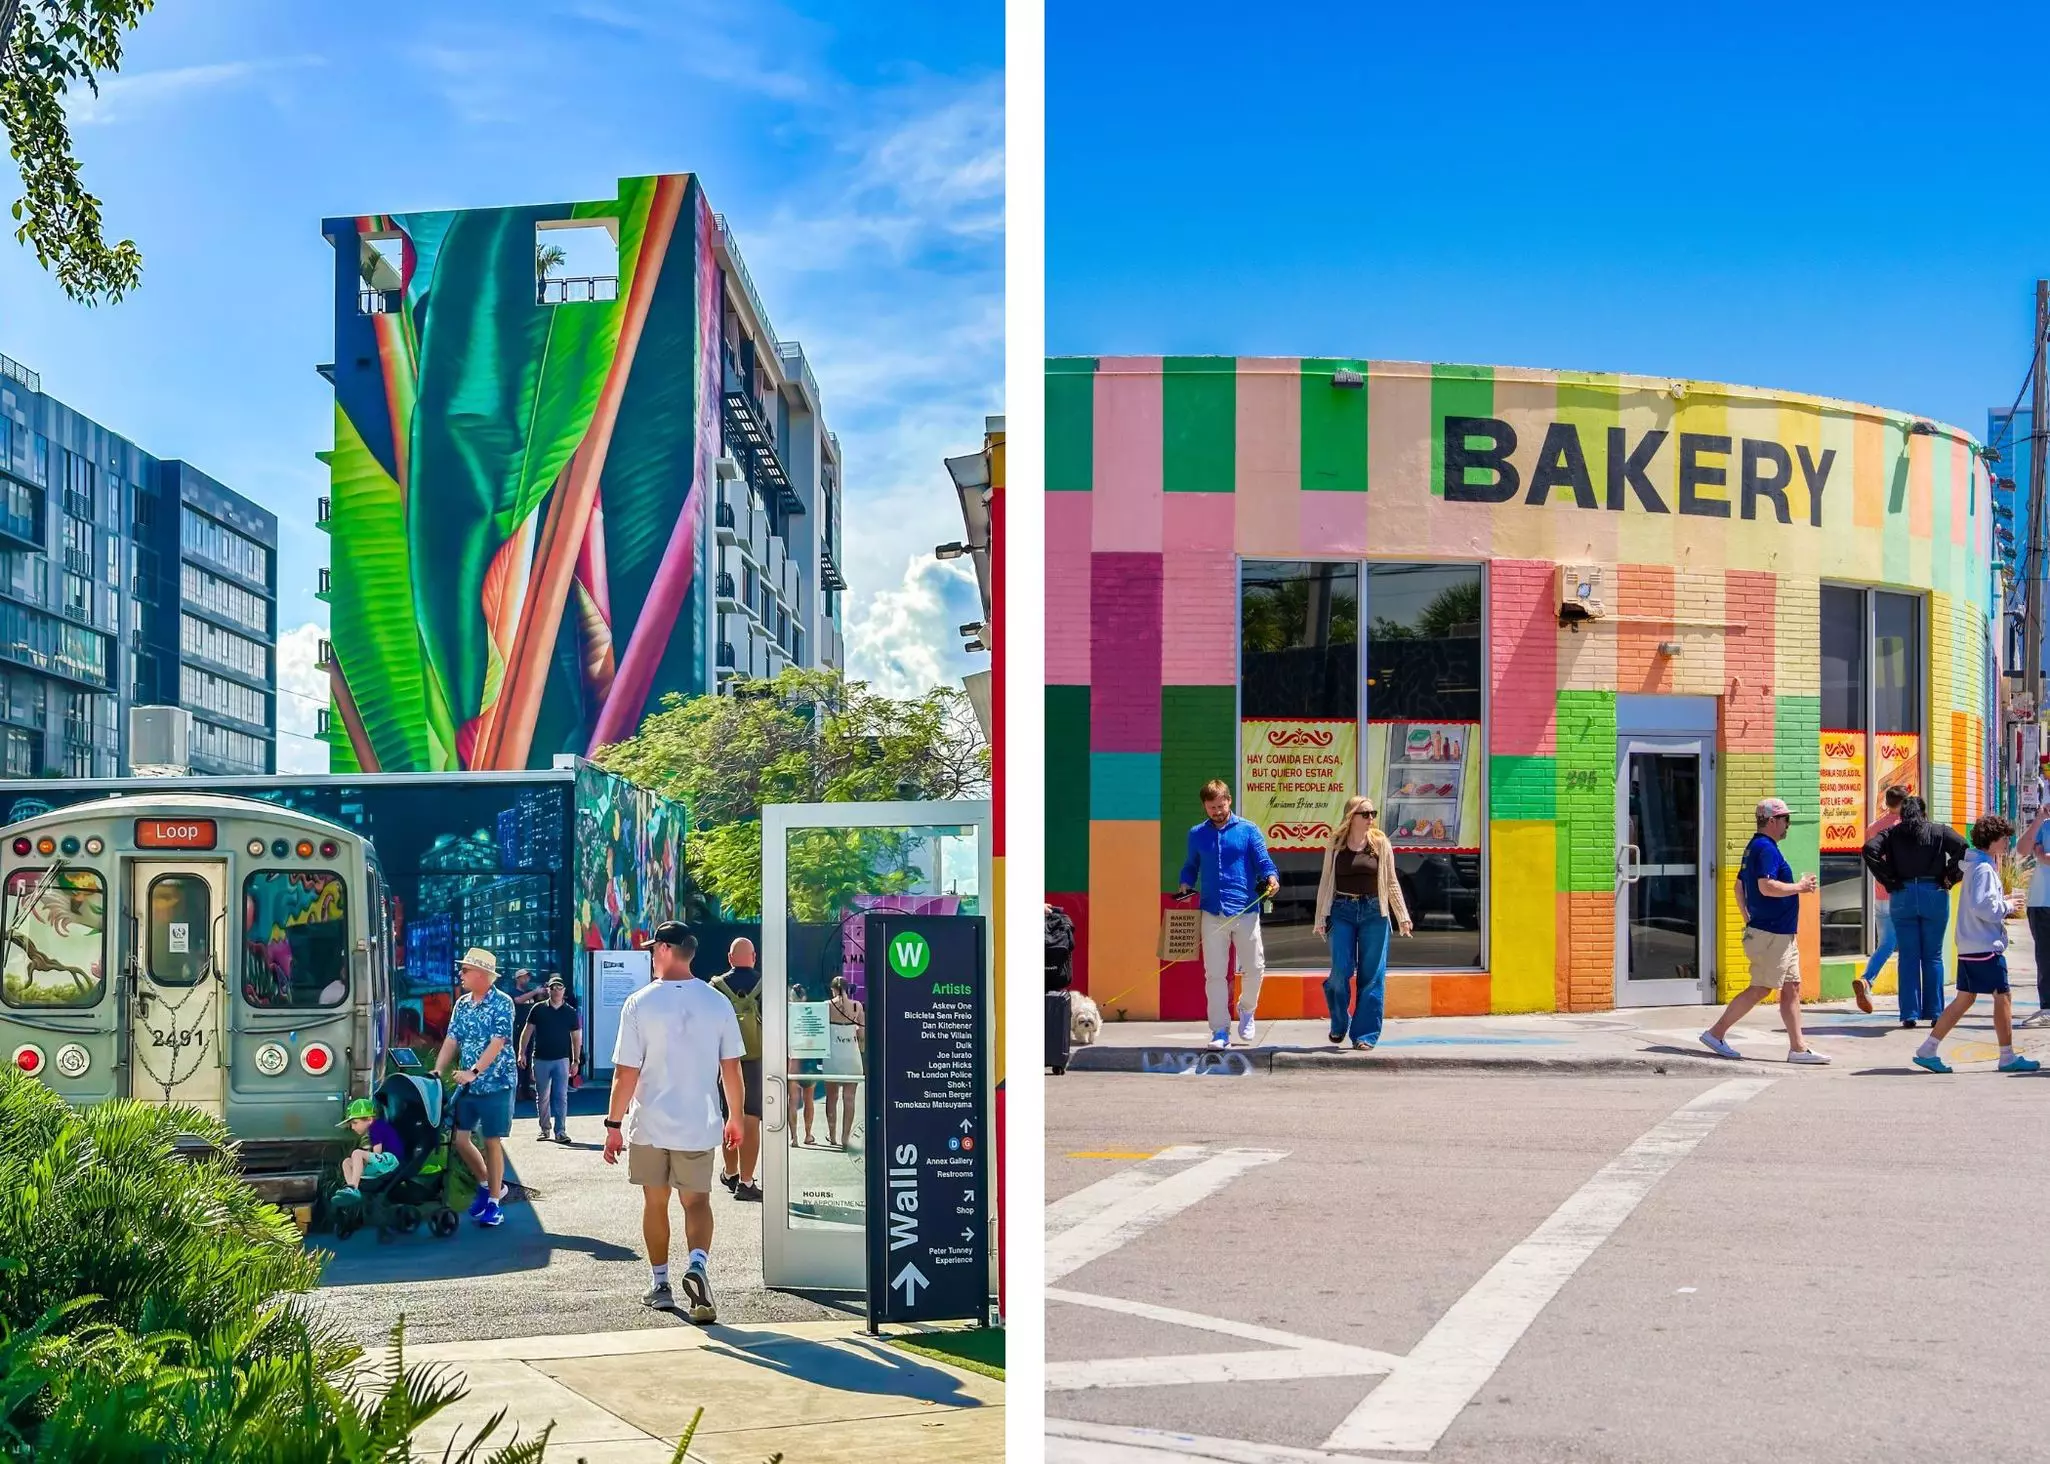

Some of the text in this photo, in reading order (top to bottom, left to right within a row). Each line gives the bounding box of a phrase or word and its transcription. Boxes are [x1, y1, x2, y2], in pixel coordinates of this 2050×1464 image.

[1444, 415, 1837, 528] BAKERY
[1247, 754, 1344, 766] HAY COMIDA EN CASA,
[1252, 768, 1333, 779] BUT QUIERO ESTAR
[1246, 783, 1344, 793] WHERE THE PEOPLE ARE
[156, 823, 198, 840] Loop
[896, 942, 923, 967] W
[932, 983, 972, 995] Artists
[932, 1002, 972, 1010] Askew One
[152, 1029, 203, 1047] 2491
[937, 1051, 950, 1059] Joe
[928, 1061, 972, 1070] Logan Hicks
[906, 1071, 972, 1079] The London Police
[948, 1091, 972, 1099] Berger
[894, 1101, 972, 1110] Tomokazu Matsuyama
[926, 1157, 973, 1166] Annex Gallery
[937, 1170, 974, 1178] Restrooms
[802, 1191, 834, 1199] HOURS:
[889, 1143, 919, 1251] Walls
[956, 1206, 975, 1216] Shop
[929, 1247, 973, 1256] Peter Tunney
[935, 1256, 973, 1264] Experience
